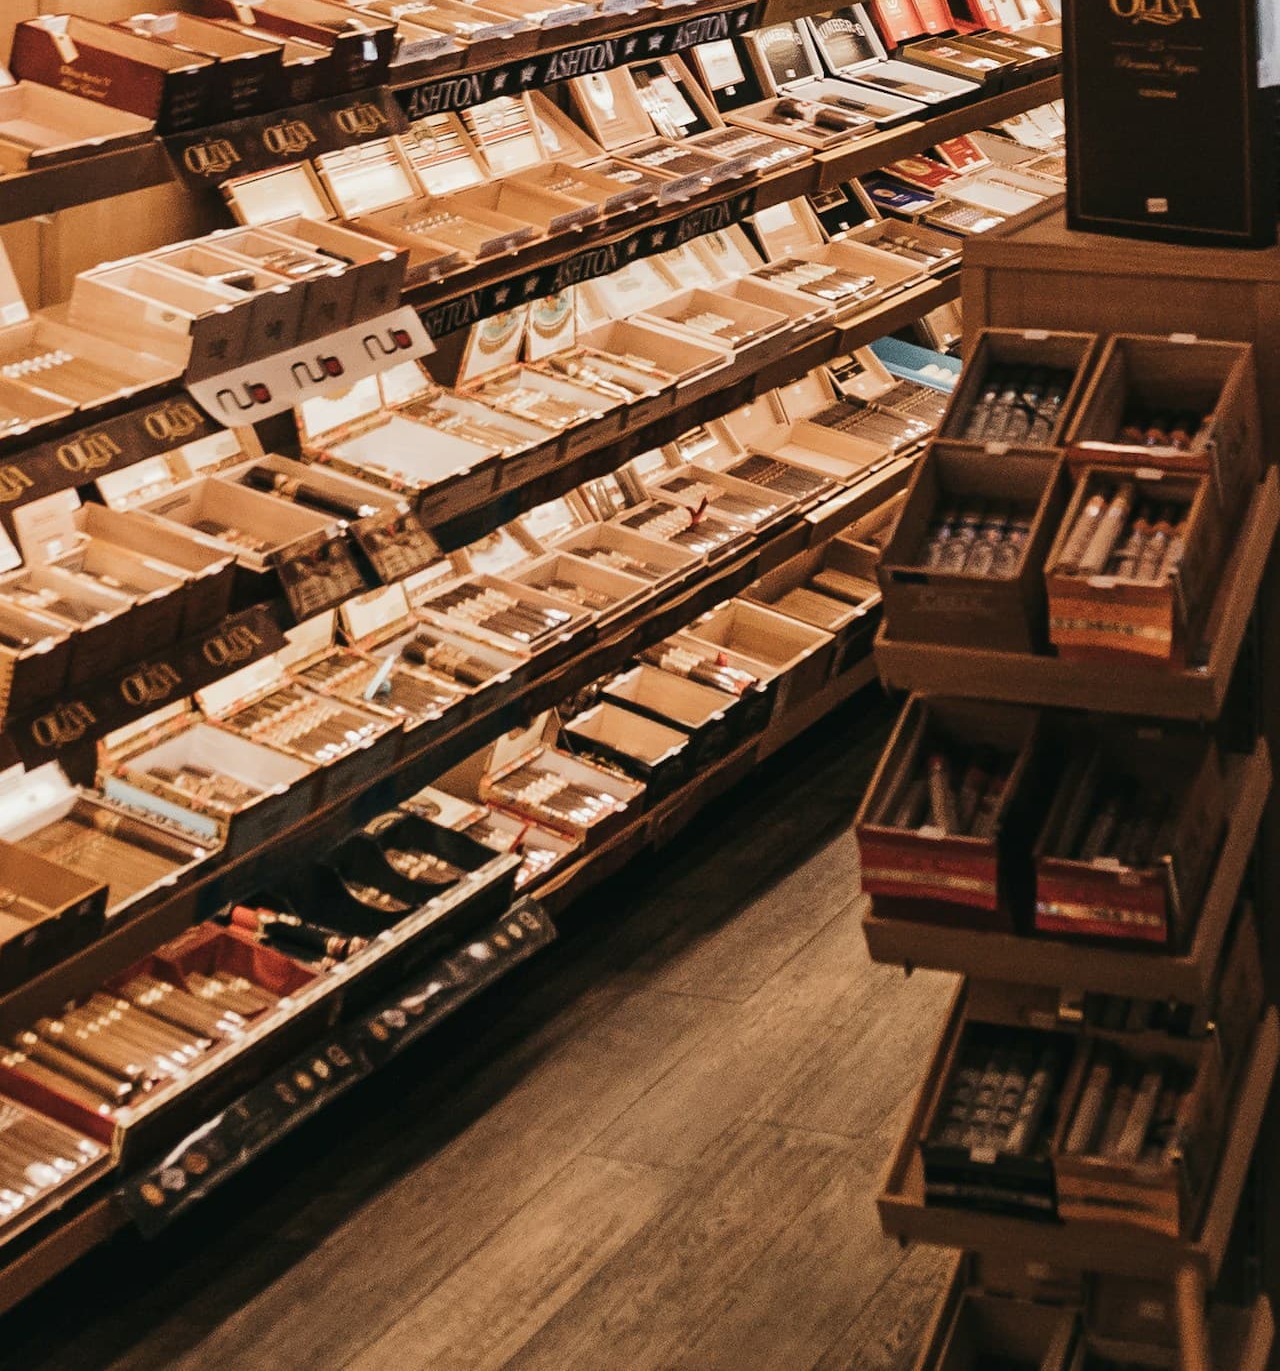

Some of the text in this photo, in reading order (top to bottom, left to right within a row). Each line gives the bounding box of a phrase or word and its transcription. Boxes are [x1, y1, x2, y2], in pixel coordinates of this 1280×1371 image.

[670, 12, 729, 52] ASHTON
[544, 40, 621, 83] ASHTON
[407, 75, 488, 118] ASHTON
[262, 118, 318, 157] OLIVA
[335, 101, 388, 138] OLIVA
[184, 135, 243, 176] OLIVA
[675, 201, 733, 243] ASHTON
[551, 247, 618, 290] ASHTON
[361, 326, 414, 362] nub
[290, 354, 345, 391] nub
[216, 380, 273, 415] nub
[143, 400, 205, 442] OLIVA
[56, 431, 122, 474] OLIVA
[202, 624, 264, 667] OLIVA
[120, 662, 182, 707] OLIVA
[31, 701, 96, 748] OLIVA
